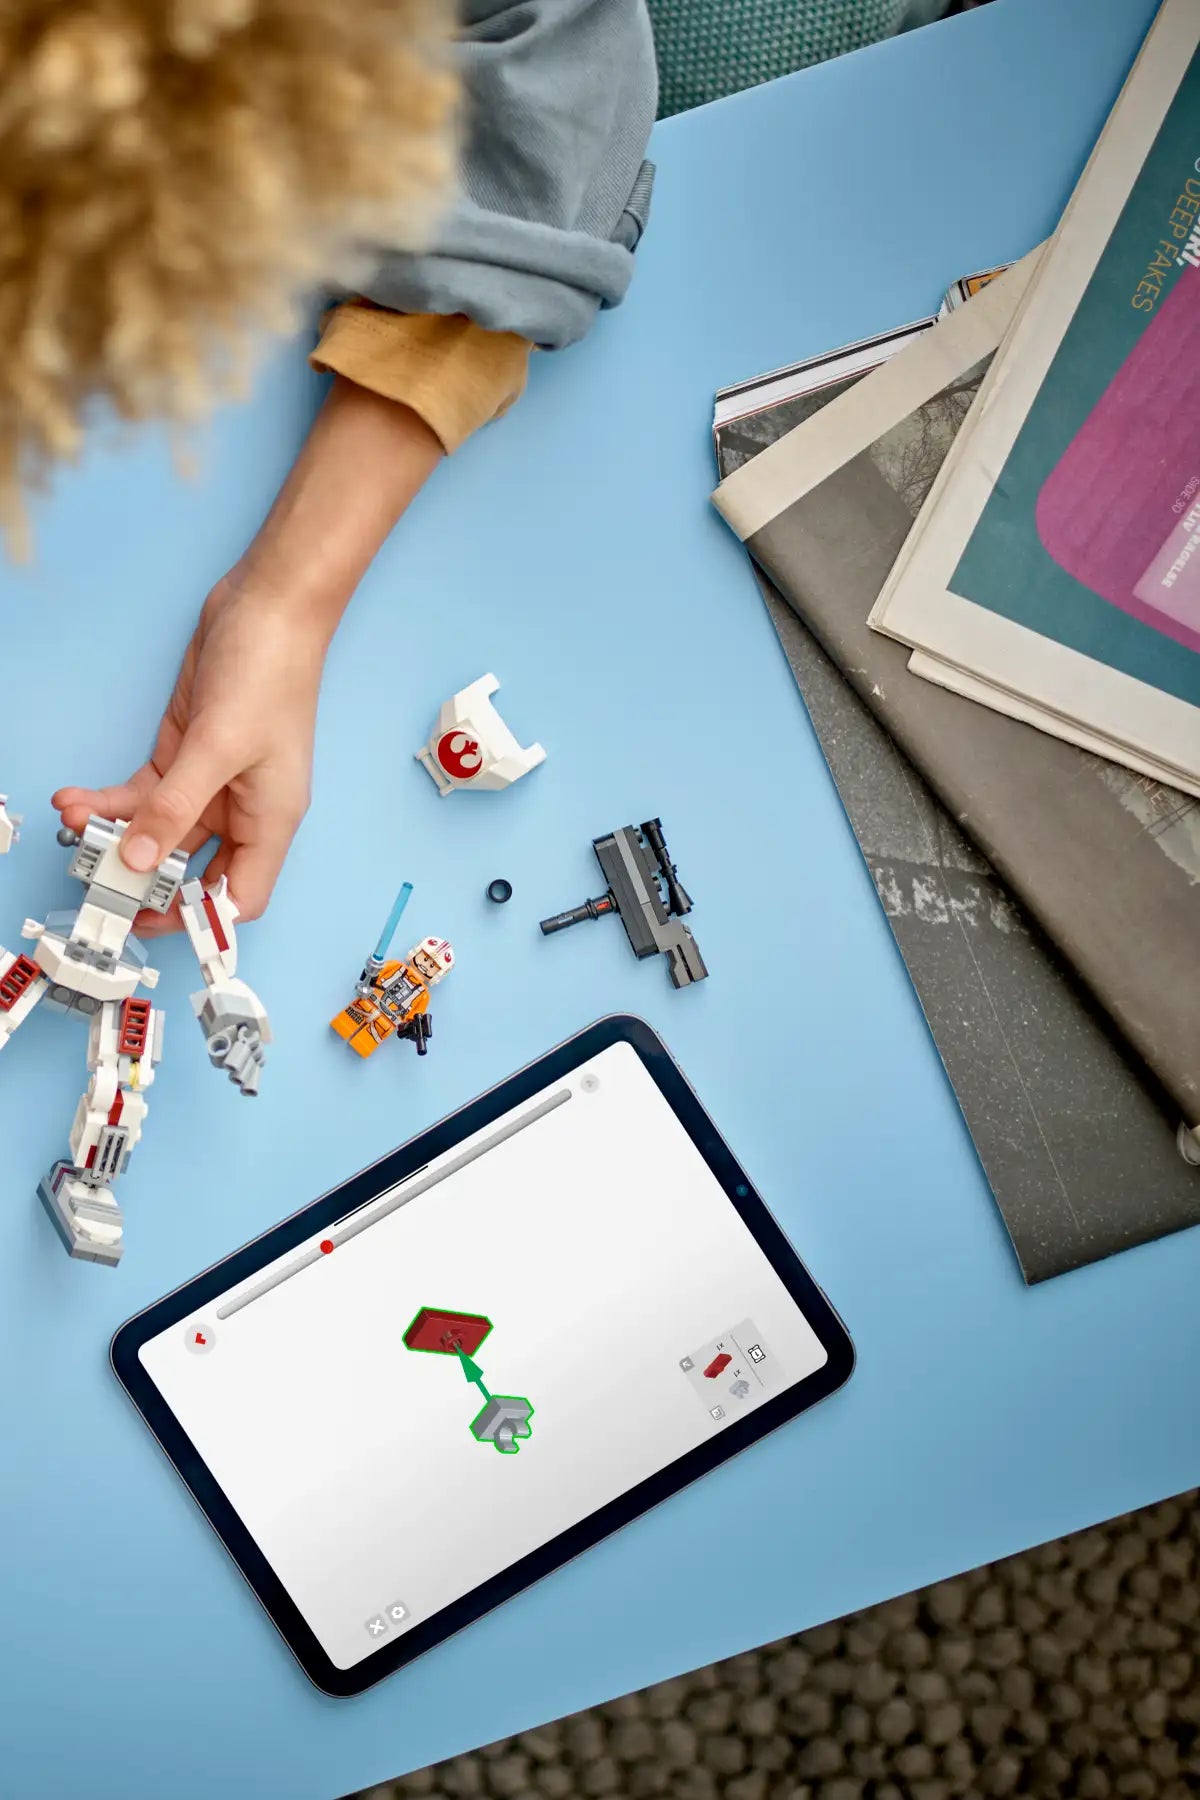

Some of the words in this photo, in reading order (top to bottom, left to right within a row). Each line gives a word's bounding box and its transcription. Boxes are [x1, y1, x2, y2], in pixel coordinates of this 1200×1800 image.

[1168, 178, 1200, 239] DEEP
[1131, 239, 1179, 312] FAKES
[1172, 498, 1186, 514] 30
